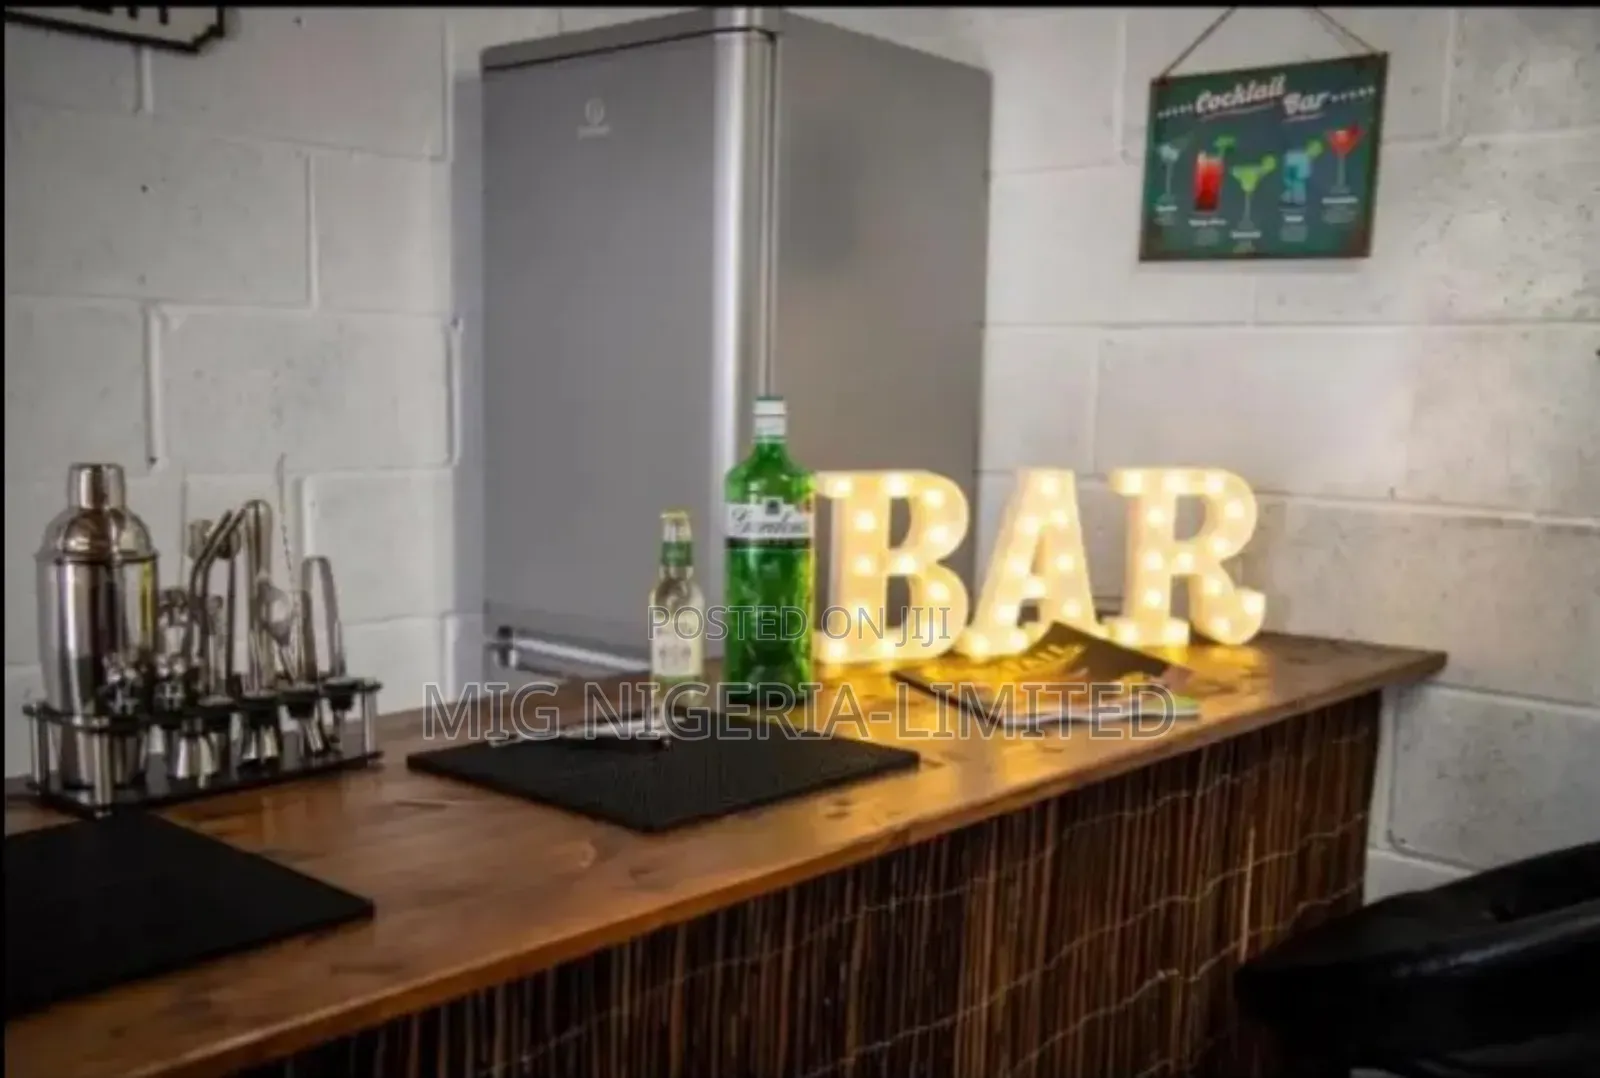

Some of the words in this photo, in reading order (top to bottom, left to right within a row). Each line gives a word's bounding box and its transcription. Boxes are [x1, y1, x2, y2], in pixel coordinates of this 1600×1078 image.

[1195, 74, 1287, 113] Cocktail
[1283, 91, 1329, 115] Bar
[812, 467, 1266, 665] BAR
